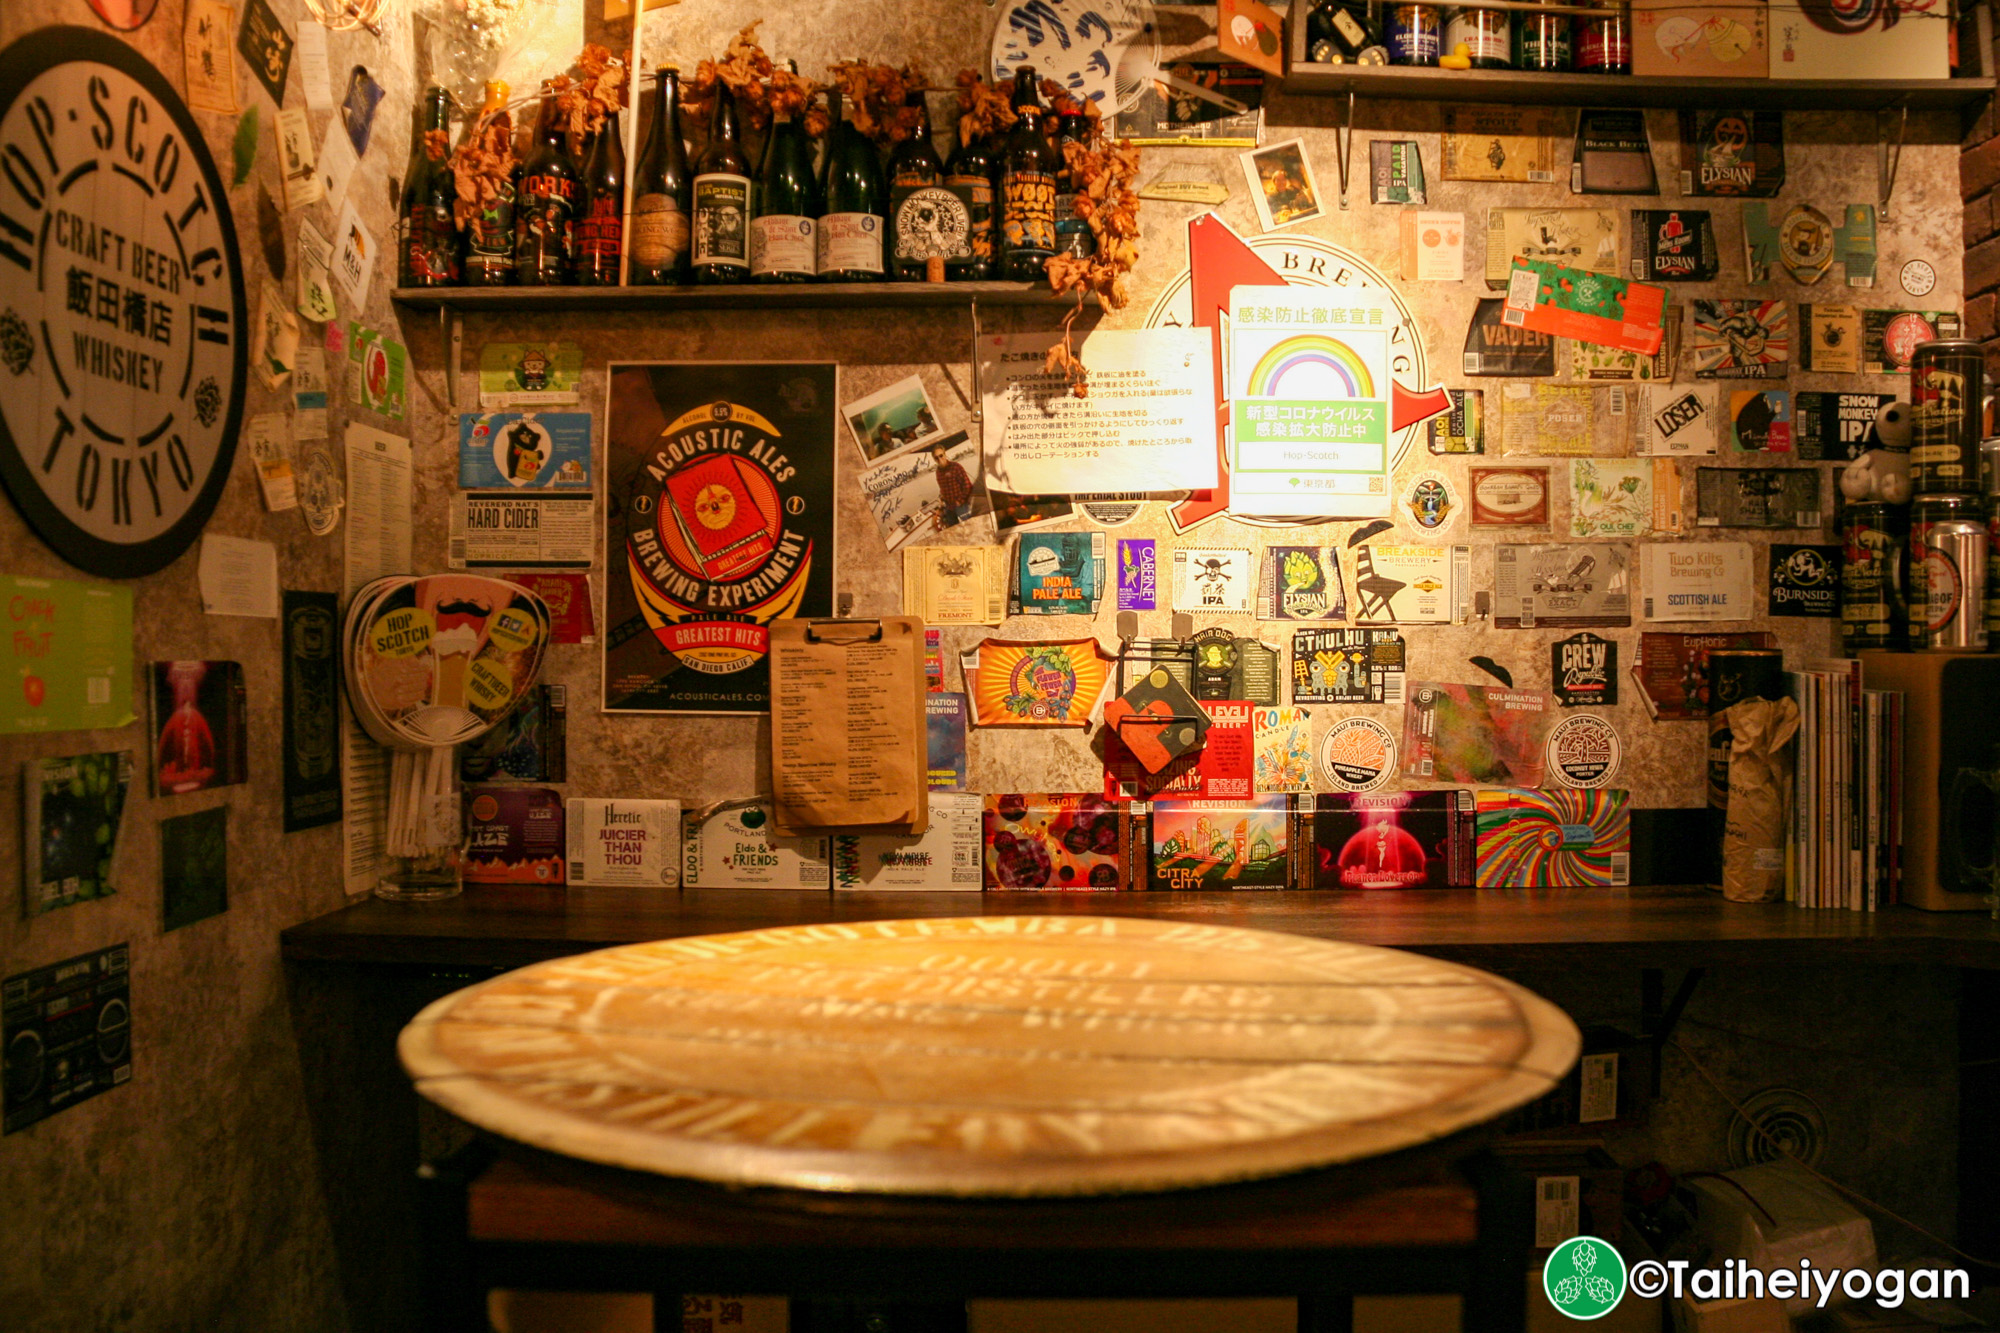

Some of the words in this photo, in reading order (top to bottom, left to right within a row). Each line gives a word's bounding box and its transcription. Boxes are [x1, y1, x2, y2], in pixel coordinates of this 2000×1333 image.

[1701, 167, 1752, 185] ELYSIAN
[698, 186, 746, 196] BAPTIST
[56, 209, 126, 271] CRAFT
[131, 242, 181, 295] BEER
[1655, 256, 1695, 270] ELYSIAN
[66, 264, 173, 347] 飯田橋店
[1237, 306, 1384, 325] 感染防止徹底宣言
[1482, 324, 1549, 347] VADER
[73, 330, 164, 394] WHISKEY
[1744, 364, 1766, 376] IPA
[1456, 391, 1464, 407] ALE
[1838, 395, 1880, 408] SNOW
[1246, 405, 1376, 421] 新型コロナウイルス
[1653, 394, 1705, 438] LOSER
[1838, 408, 1879, 421] MONKEY
[1255, 422, 1367, 438] 感染拡大防止中
[1456, 410, 1464, 436] OCHA
[646, 428, 744, 482] ACOUSTIC
[749, 438, 796, 483] ALES
[1283, 450, 1339, 461] Hop-Scotch
[42, 405, 194, 526] TOKYO
[1303, 478, 1336, 489] 東京都
[467, 508, 500, 528] HARD
[503, 508, 539, 528] CIDER
[1618, 522, 1635, 530] CHEF
[1376, 548, 1445, 557] BREAKSIDE
[1668, 551, 1694, 566] Two
[1696, 551, 1723, 565] Kilts
[633, 529, 699, 603] BREWING
[708, 529, 805, 607] EXPERIMENT
[1141, 546, 1155, 602] CABERNET
[1670, 566, 1711, 578] Brewing
[1042, 577, 1072, 588] INDIA
[1032, 588, 1059, 600] PALE
[1061, 588, 1082, 599] ALE
[1202, 596, 1224, 605] IPA
[1283, 592, 1327, 608] ELYSIAN
[1668, 594, 1709, 606] SCOTTISH
[1711, 593, 1728, 605] ALE
[1772, 586, 1836, 604] BURNSIDE
[387, 613, 413, 633] HOP
[376, 624, 430, 653] SCOTCH
[676, 628, 731, 645] GREATEST
[735, 629, 762, 646] HITS
[1193, 630, 1214, 643] HAIR
[1215, 630, 1233, 642] DOG
[1294, 630, 1365, 651] CTHULHU
[683, 655, 699, 669] SAN
[701, 663, 724, 673] DIEGO
[1562, 643, 1607, 671] CREW
[468, 677, 498, 703] WHISKY
[1488, 692, 1543, 704] CULMINATION
[924, 706, 959, 715] REWING
[1505, 701, 1543, 712] BREWING
[1330, 723, 1349, 739] MAUI
[1350, 720, 1384, 738] BREWING
[1552, 722, 1570, 742] MAUI
[1569, 716, 1605, 732] BREWING
[1334, 764, 1360, 774] PINEAPPLE
[1360, 768, 1376, 777] MANA
[1345, 772, 1364, 780] WHEAT
[1565, 764, 1588, 773] COCONUT
[1329, 773, 1351, 791] ISLAND
[1351, 778, 1379, 791] BREWED
[1561, 774, 1583, 788] ISLAND
[1584, 770, 1609, 787] BREWED
[1192, 799, 1246, 809] REVISION
[1354, 796, 1407, 808] REVISION
[604, 803, 642, 827] Heretic
[599, 829, 646, 841] JUICIER
[723, 822, 767, 837] PORTLAND
[604, 842, 642, 853] THAN
[735, 842, 755, 853] Eldo
[757, 842, 767, 853] &
[604, 853, 642, 865] THOU
[733, 854, 778, 867] FRIENDS
[686, 858, 699, 884] ELDO
[1156, 867, 1200, 878] CITRA
[1170, 877, 1204, 889] CITY
